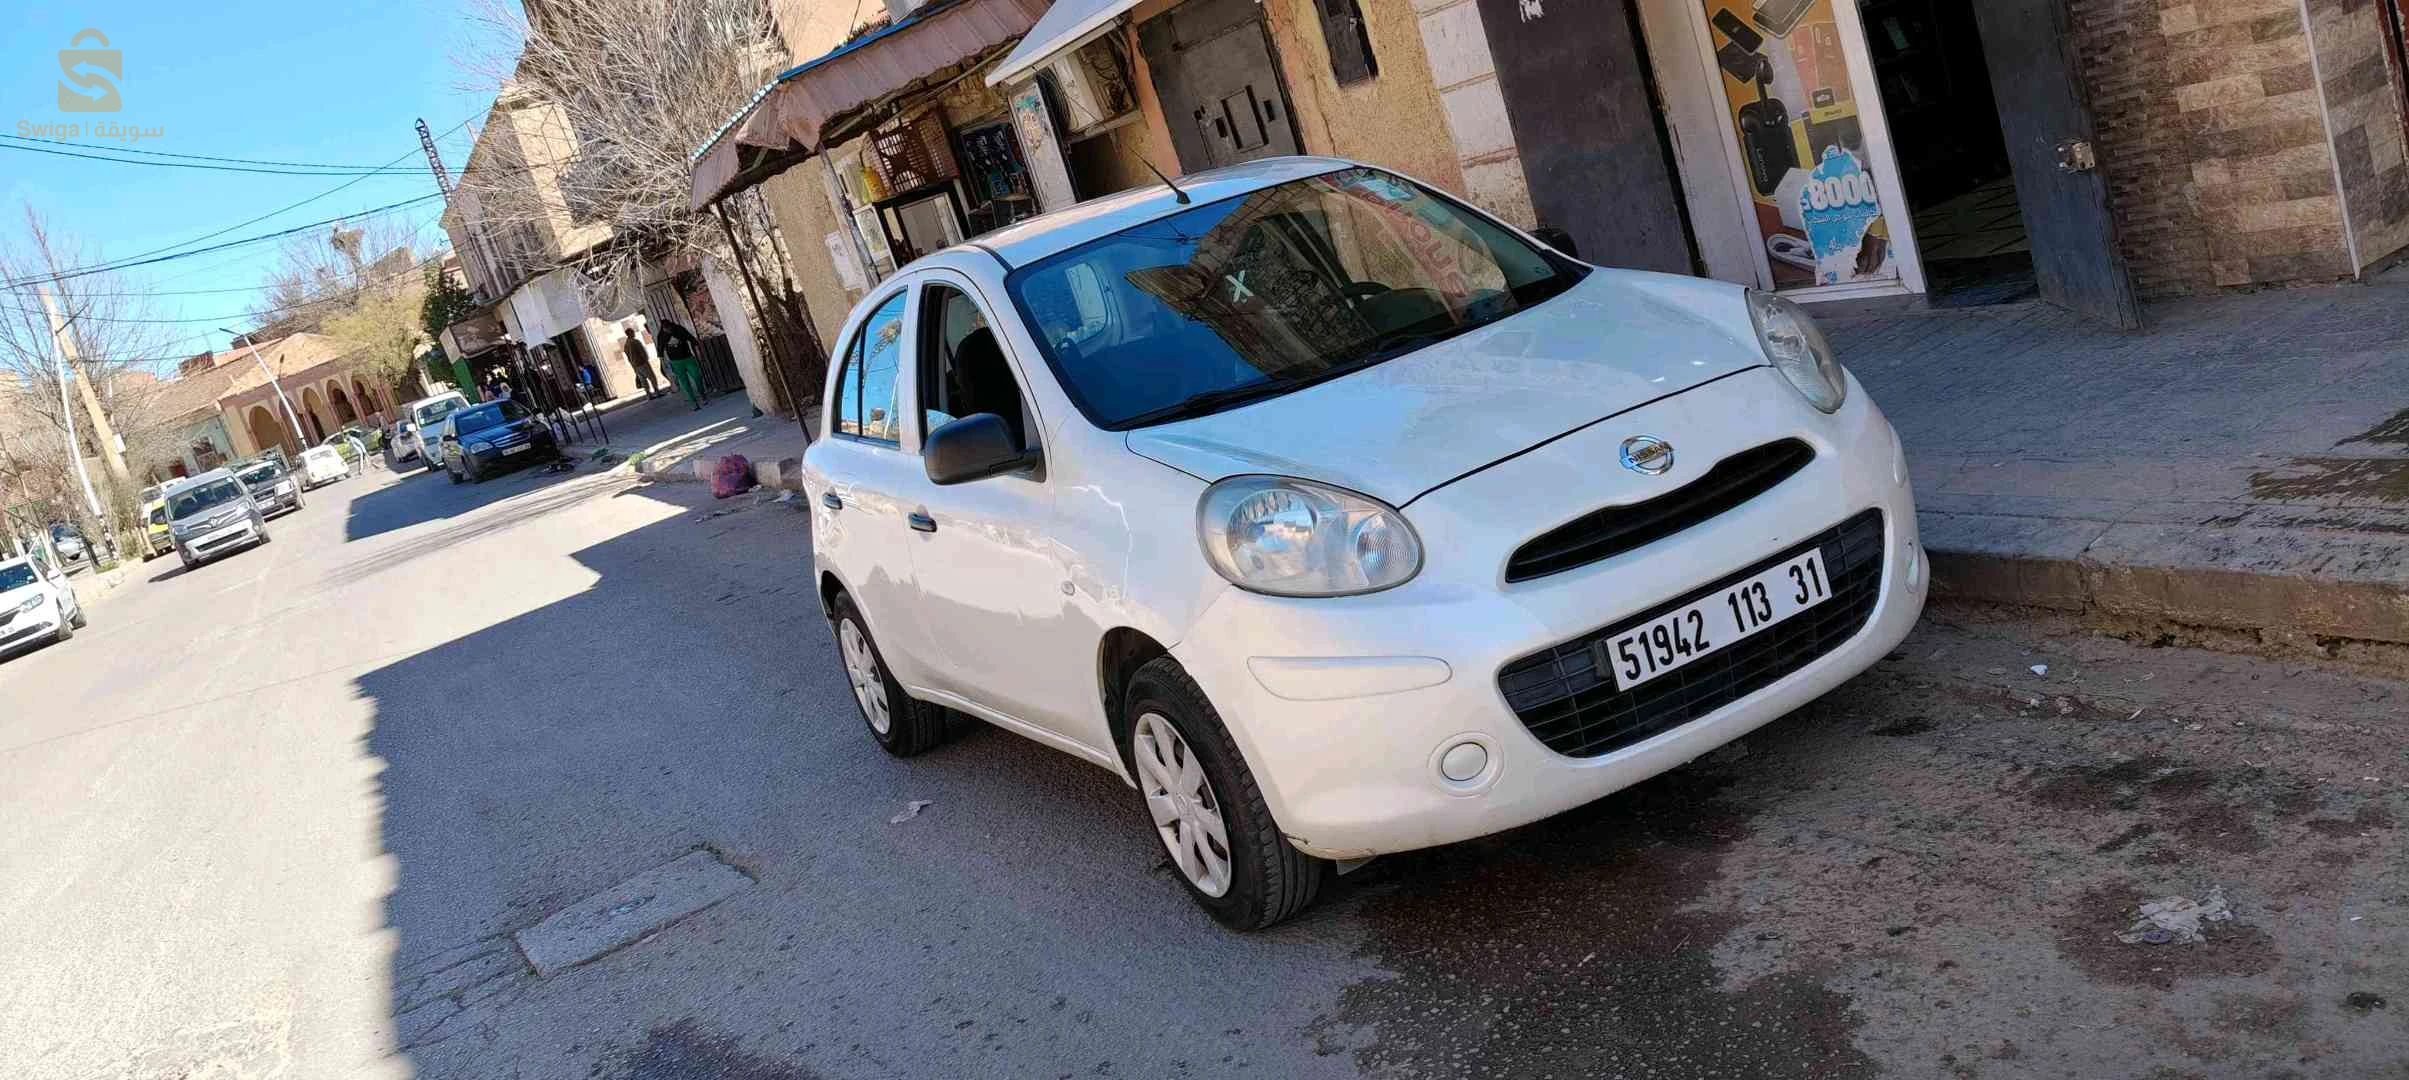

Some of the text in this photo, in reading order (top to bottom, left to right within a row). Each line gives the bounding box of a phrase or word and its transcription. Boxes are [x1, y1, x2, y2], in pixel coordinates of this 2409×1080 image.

[1617, 556, 1823, 681] 51942 113 31
